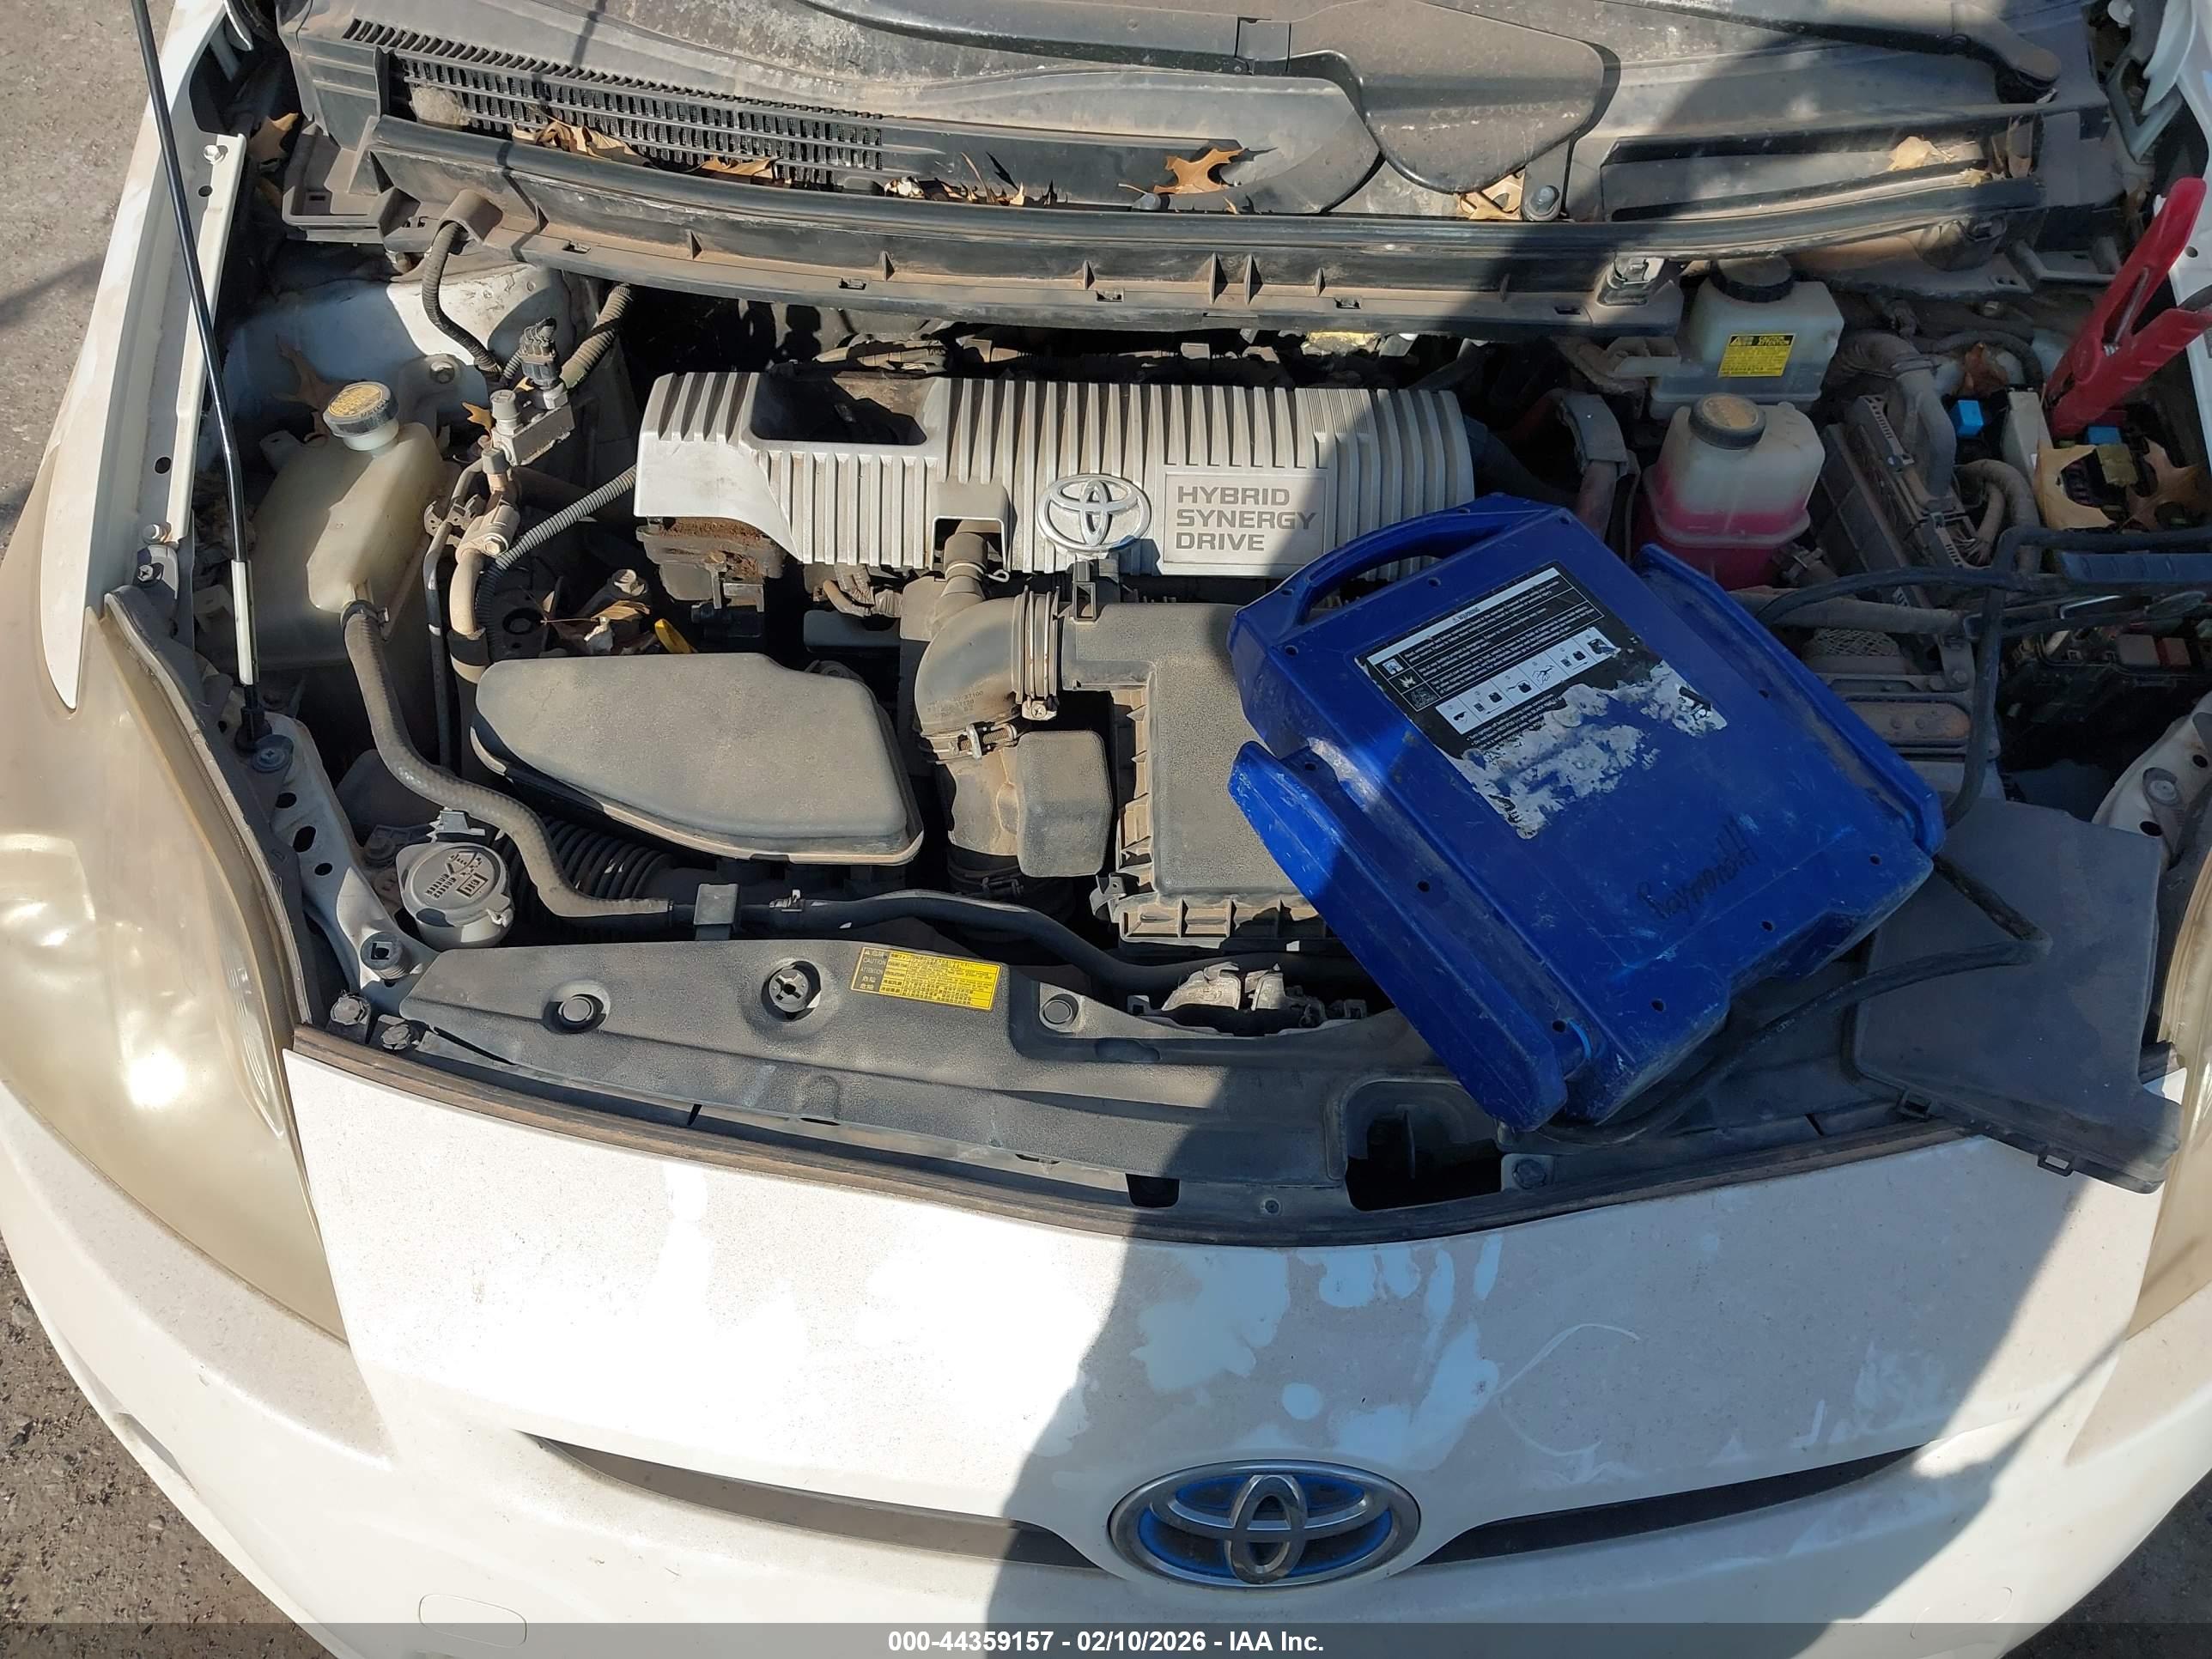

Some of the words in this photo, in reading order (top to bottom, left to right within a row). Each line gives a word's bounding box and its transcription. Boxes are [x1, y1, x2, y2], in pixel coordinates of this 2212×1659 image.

[1177, 486, 1291, 506] HYBRID
[1176, 508, 1317, 530] SYNERGY
[1176, 532, 1265, 551] DRIVE
